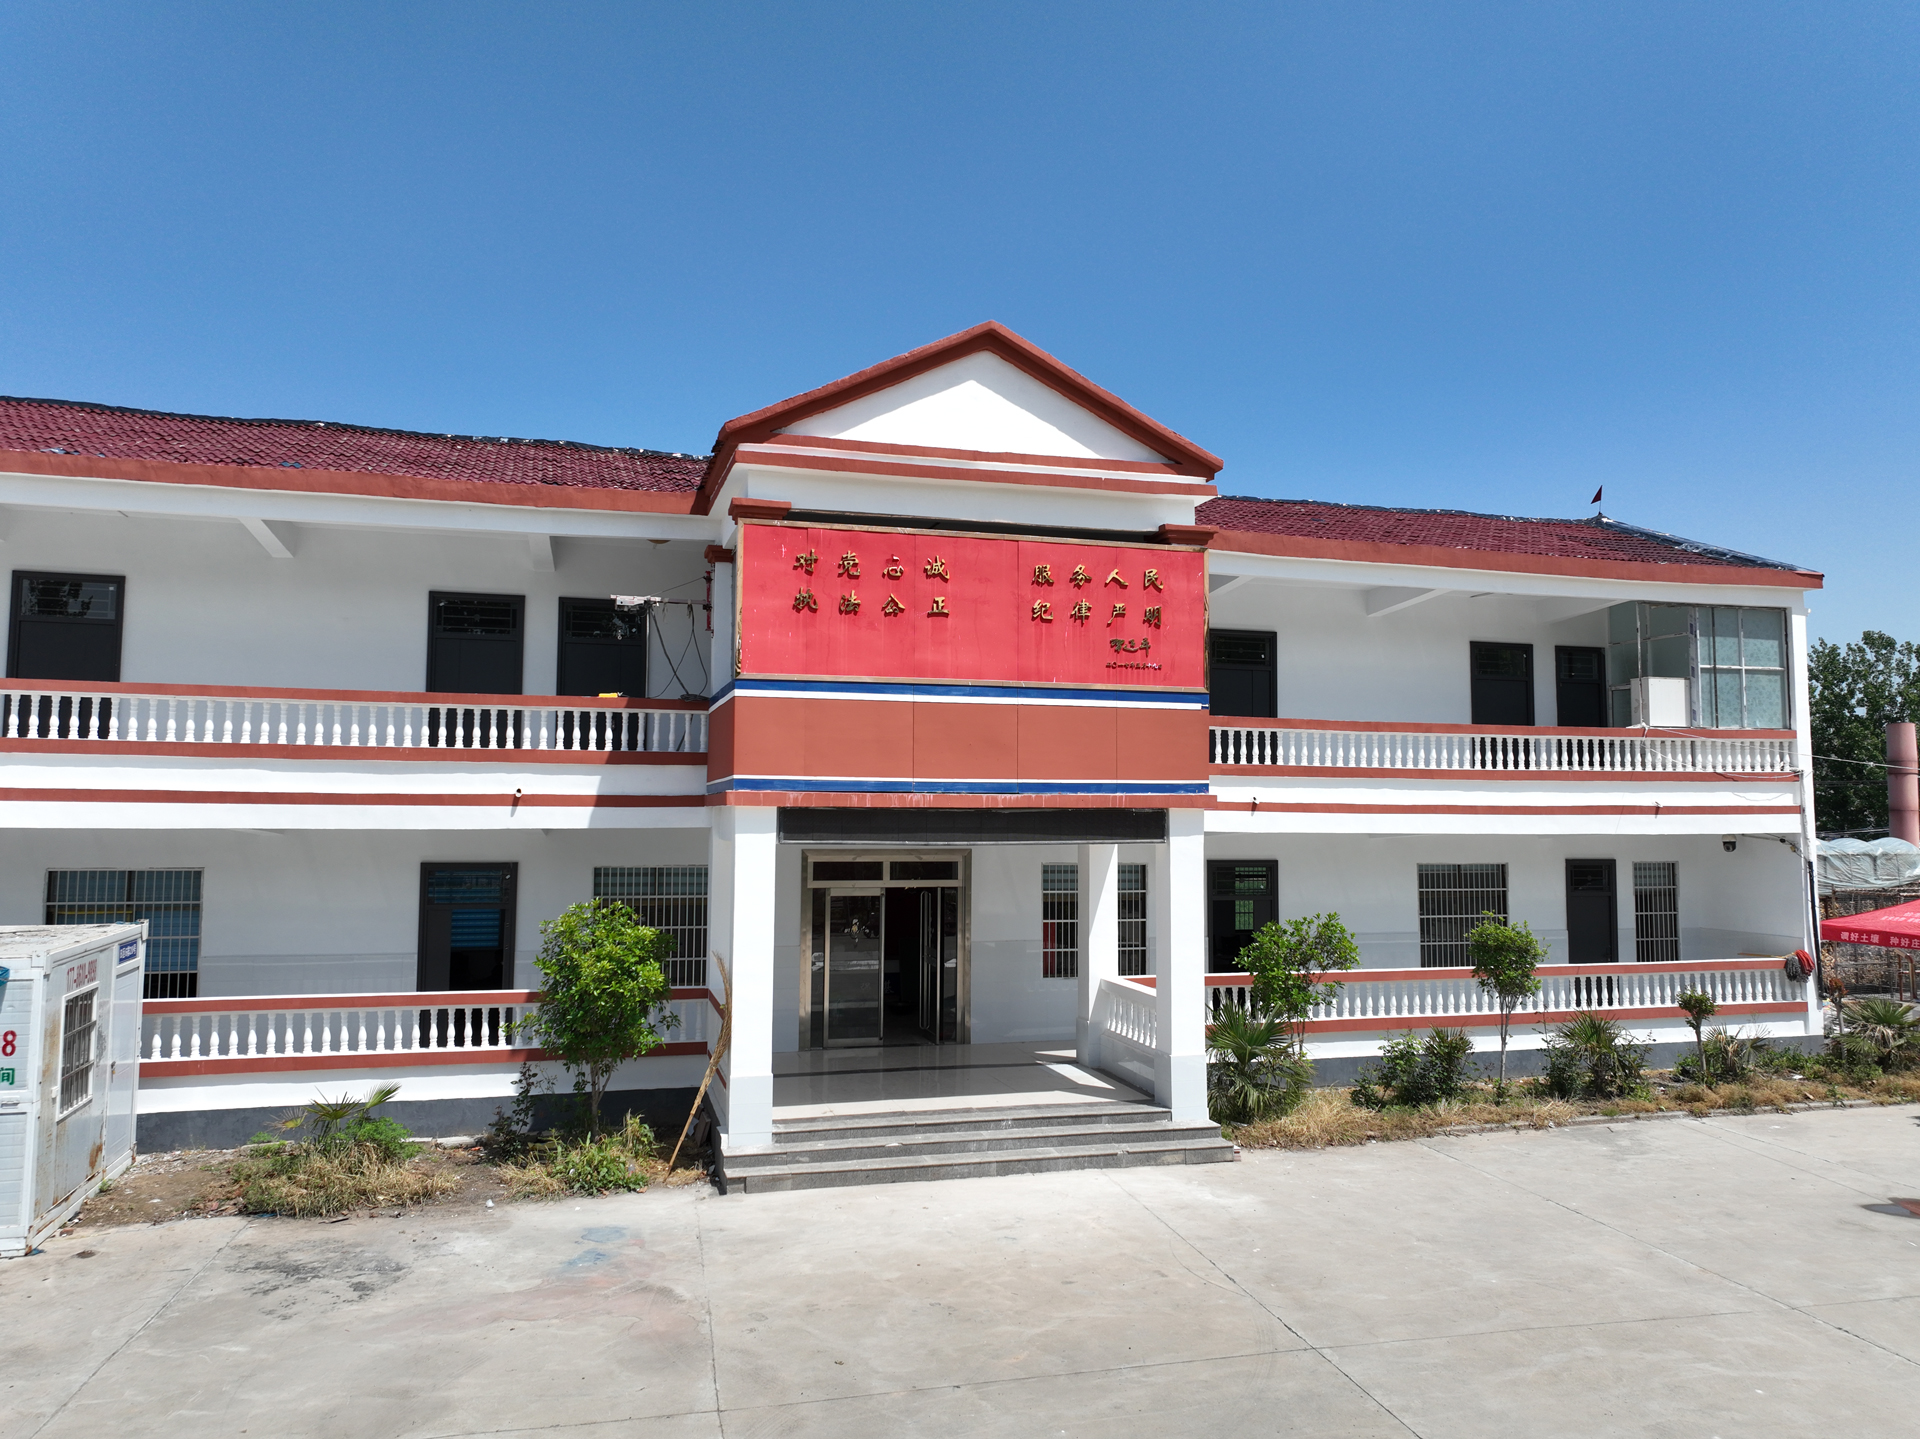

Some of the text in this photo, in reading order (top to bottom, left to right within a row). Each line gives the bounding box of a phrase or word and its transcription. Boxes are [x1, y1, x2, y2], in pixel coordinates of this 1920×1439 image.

[1032, 564, 1164, 591] 服务人民
[793, 587, 1162, 628] 执法公正 纪律严明
[1890, 936, 1920, 948] 种好庄
